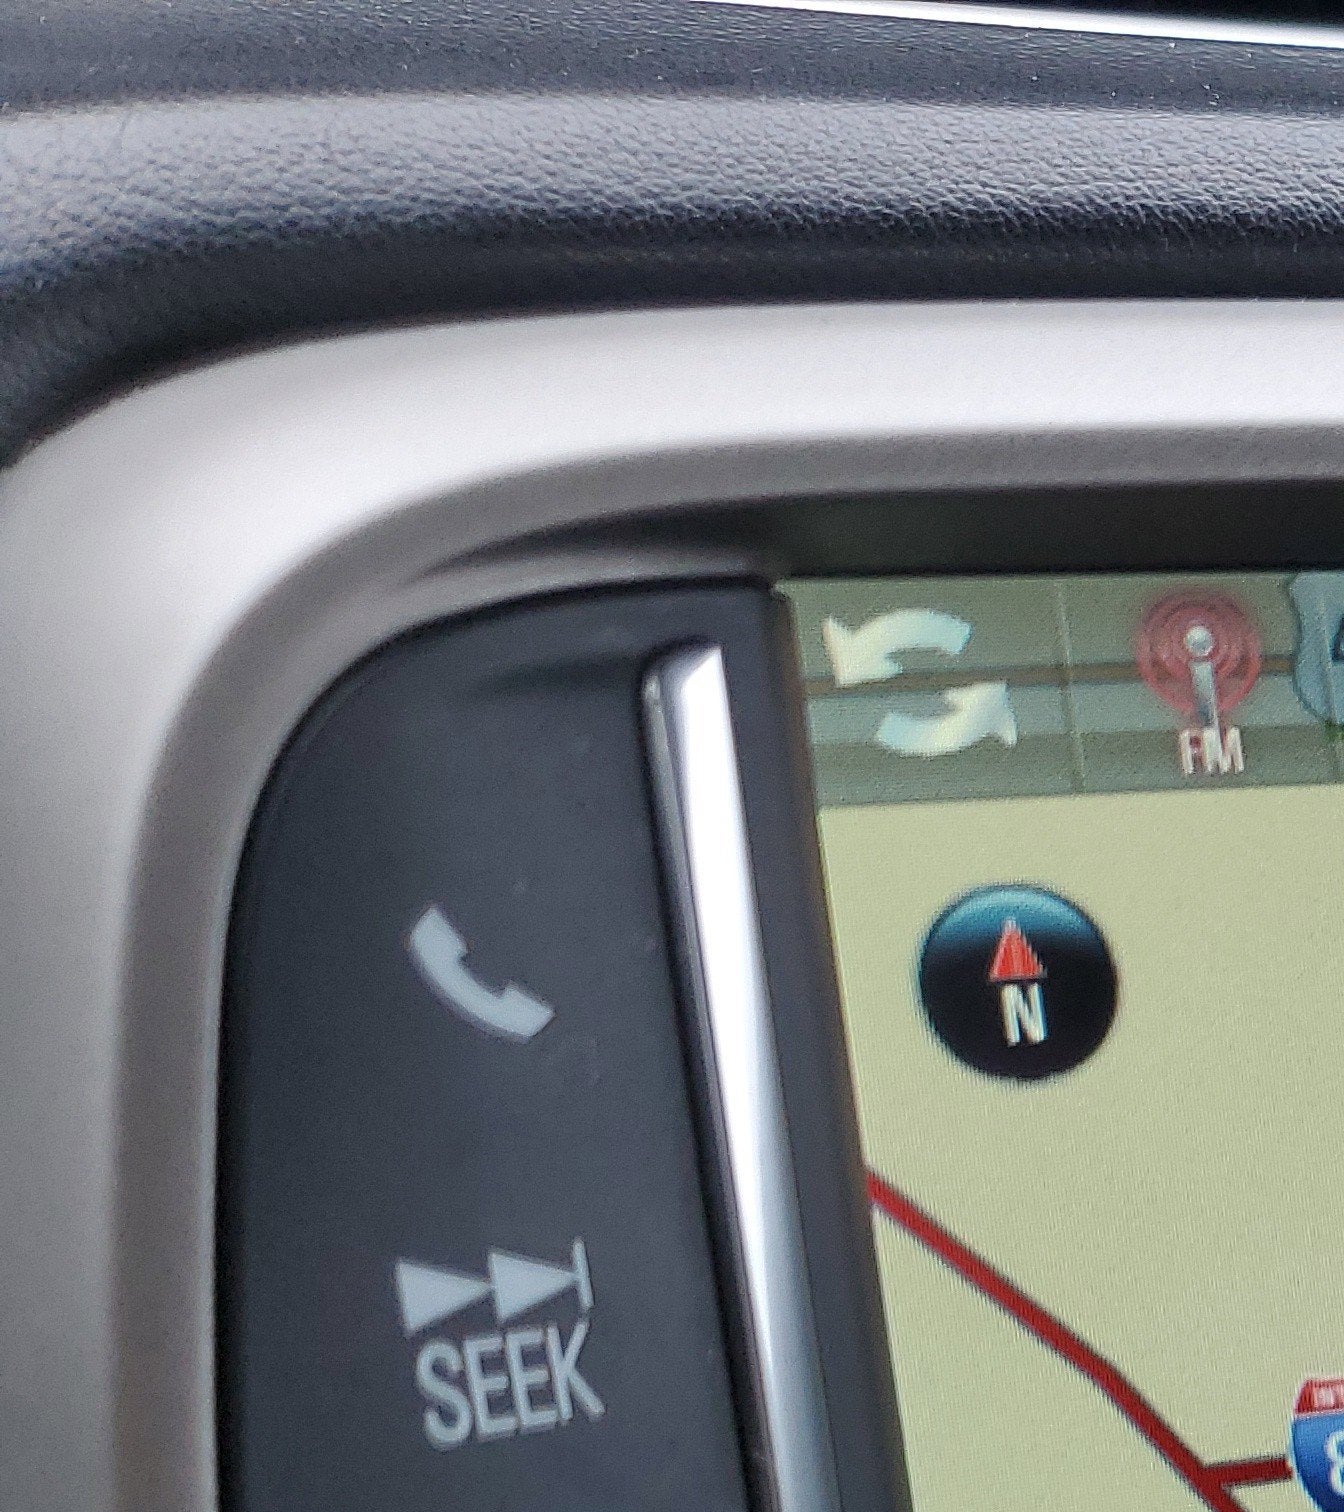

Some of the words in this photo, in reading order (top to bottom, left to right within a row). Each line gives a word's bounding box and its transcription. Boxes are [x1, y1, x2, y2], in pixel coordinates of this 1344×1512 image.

[1178, 726, 1246, 777] FM
[1001, 982, 1050, 1048] N
[415, 1321, 607, 1451] SEEK
